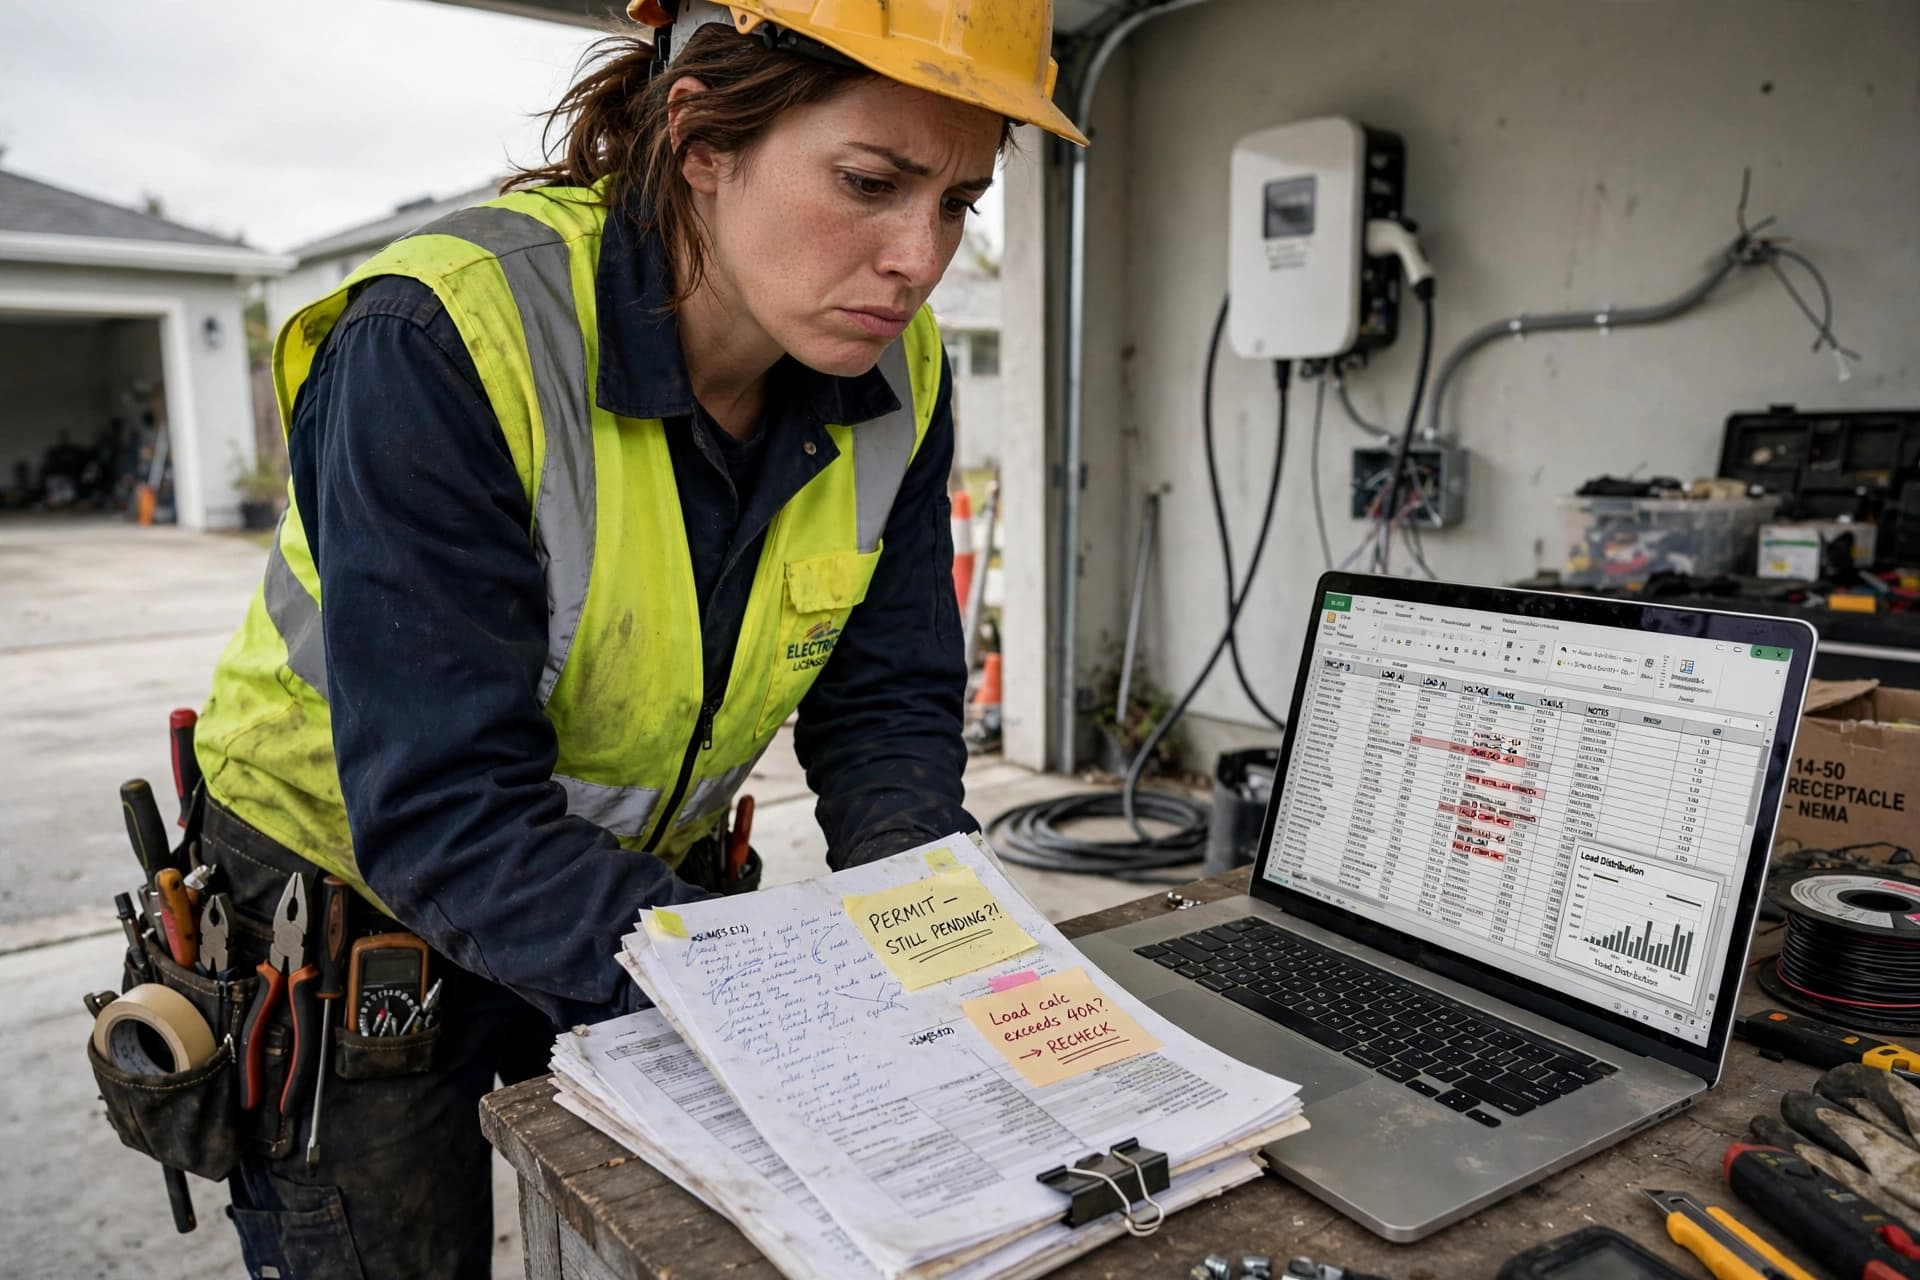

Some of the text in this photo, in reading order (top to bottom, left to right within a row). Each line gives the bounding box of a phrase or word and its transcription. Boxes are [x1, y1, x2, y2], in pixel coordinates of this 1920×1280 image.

[1587, 707, 1609, 717] NOTES
[1795, 757, 1846, 781] 14-50
[1787, 777, 1905, 812] RECEPTACLE
[1799, 801, 1849, 824] NEMA
[1580, 851, 1645, 877] Load Distribution
[868, 896, 937, 934] PERMIT
[886, 902, 1003, 955] STILL PENDING?!
[989, 992, 1071, 1026] Load calc
[1004, 997, 1110, 1043] exceeds 40A?
[1046, 1021, 1117, 1054] RECHECK
